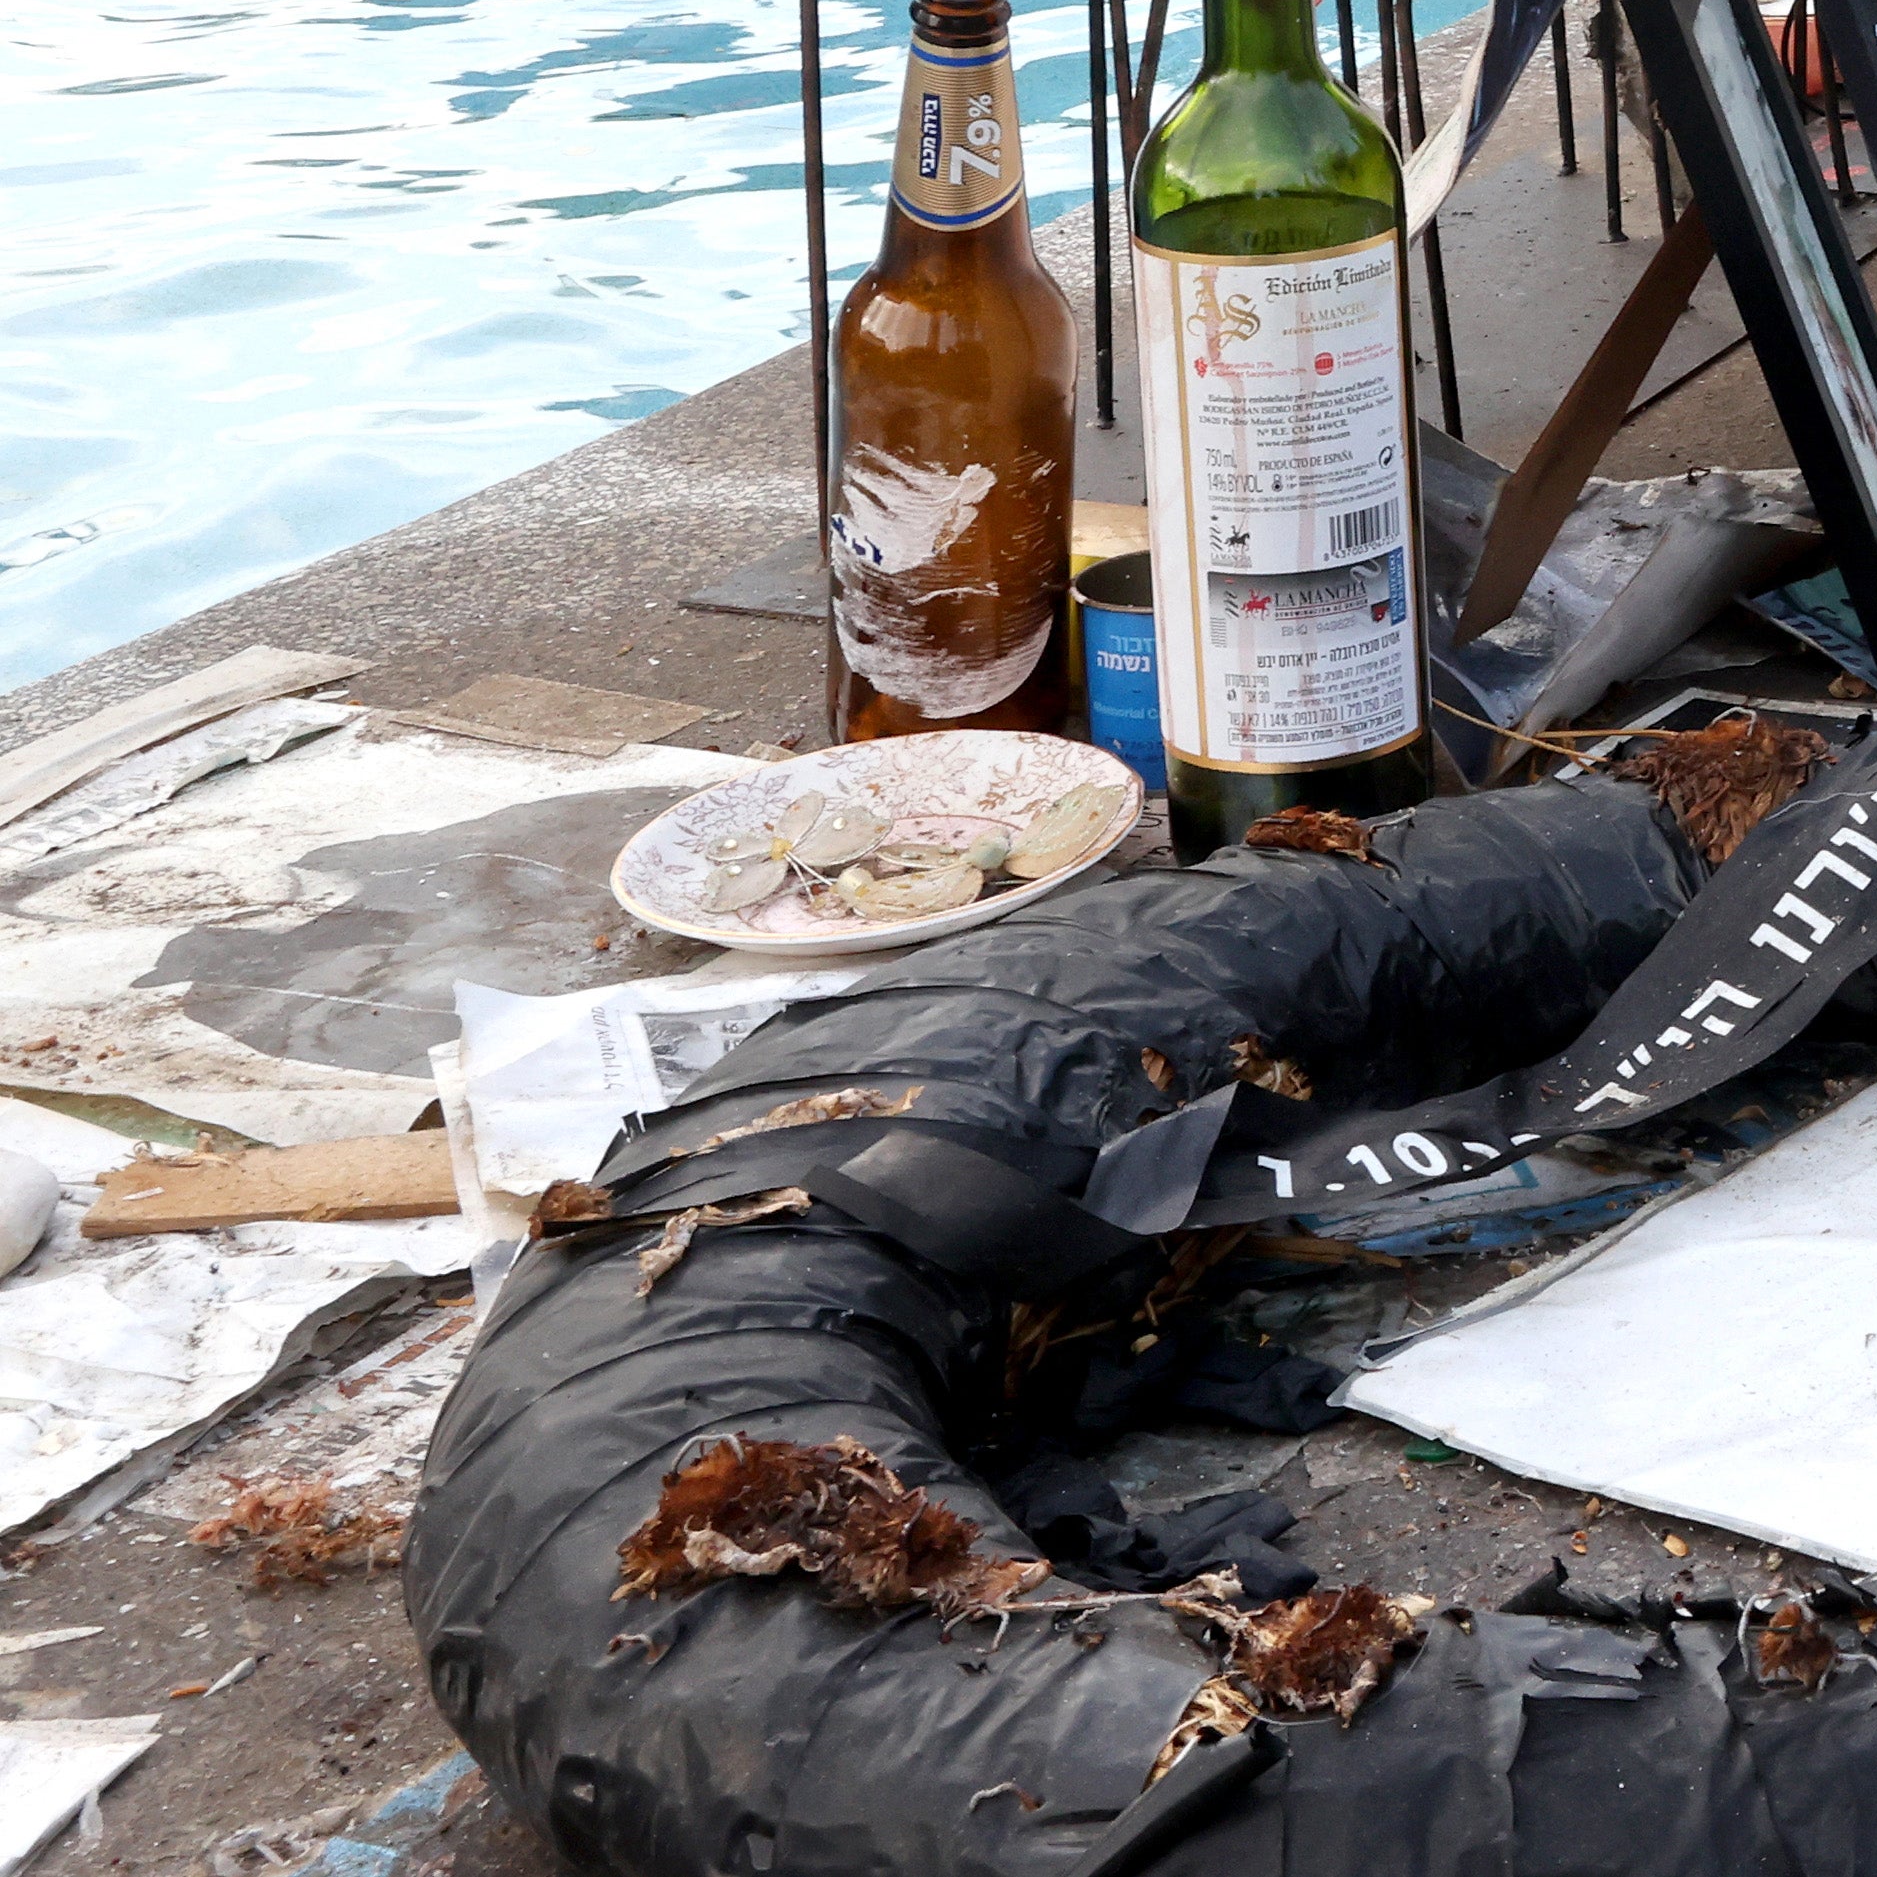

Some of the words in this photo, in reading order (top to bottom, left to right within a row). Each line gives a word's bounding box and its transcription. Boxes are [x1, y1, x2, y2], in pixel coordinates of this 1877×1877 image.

[949, 92, 1001, 186] 7.9%
[1264, 274, 1333, 303] Edición
[1333, 259, 1393, 294] Limitada
[1287, 410, 1323, 425] Ciudad
[1205, 447, 1223, 469] 750
[1258, 456, 1309, 472] PRODUCTO
[1309, 454, 1324, 468] DE
[1274, 591, 1296, 608] LA
[1298, 580, 1369, 606] MANCHA
[1096, 649, 1151, 674] נשמה
[1256, 654, 1277, 670] יבש
[1278, 653, 1305, 669] אדום
[1305, 651, 1319, 669] יין
[1573, 979, 1764, 1114] הי"ד
